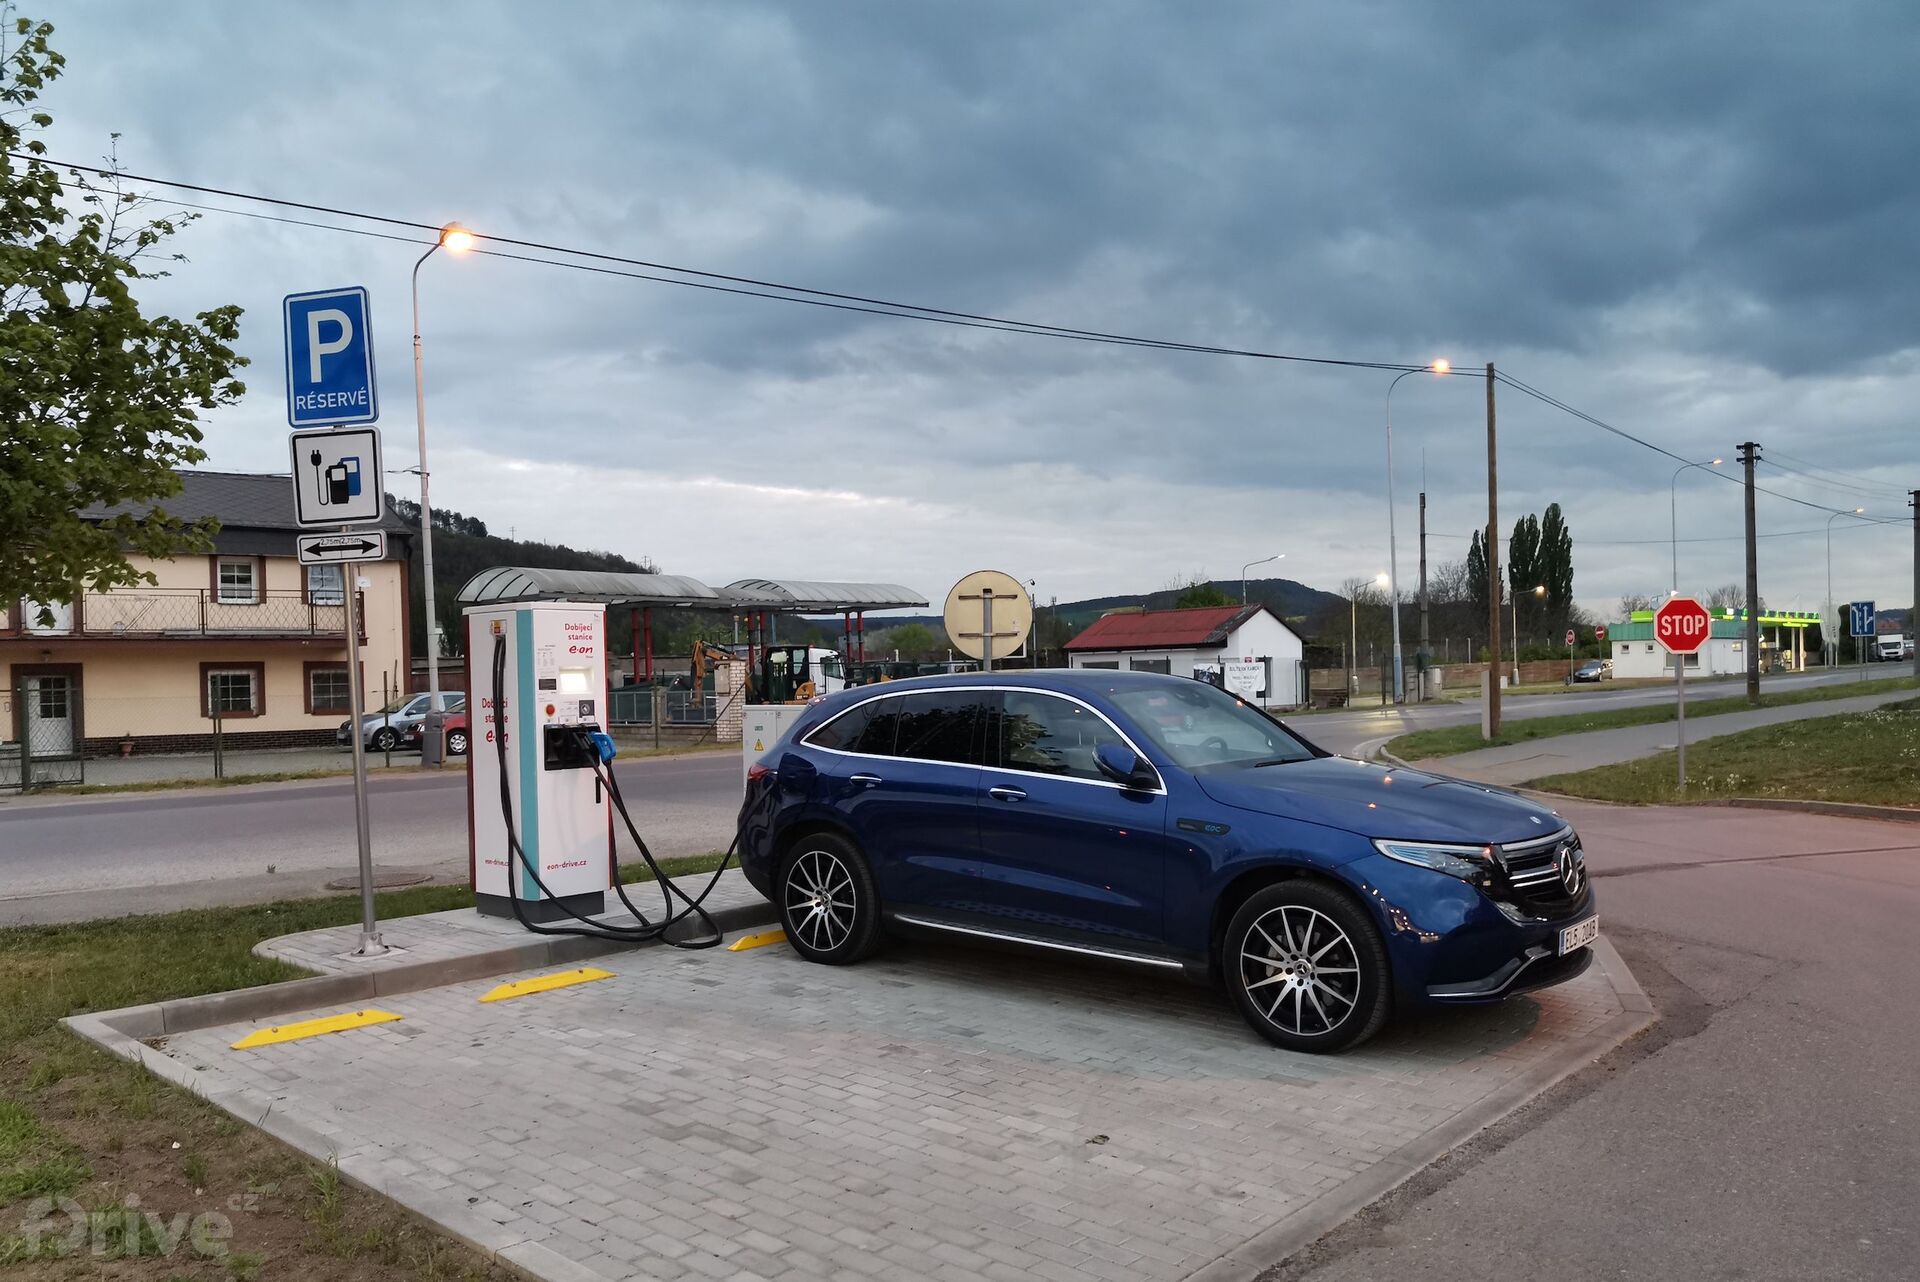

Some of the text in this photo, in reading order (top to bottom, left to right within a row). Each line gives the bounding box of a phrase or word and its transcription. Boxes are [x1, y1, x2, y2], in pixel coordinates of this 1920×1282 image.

[307, 308, 354, 384] P
[296, 386, 368, 411] RÉSERVÉ
[1660, 615, 1705, 636] STOP
[546, 859, 587, 871] eon-drive.cz
